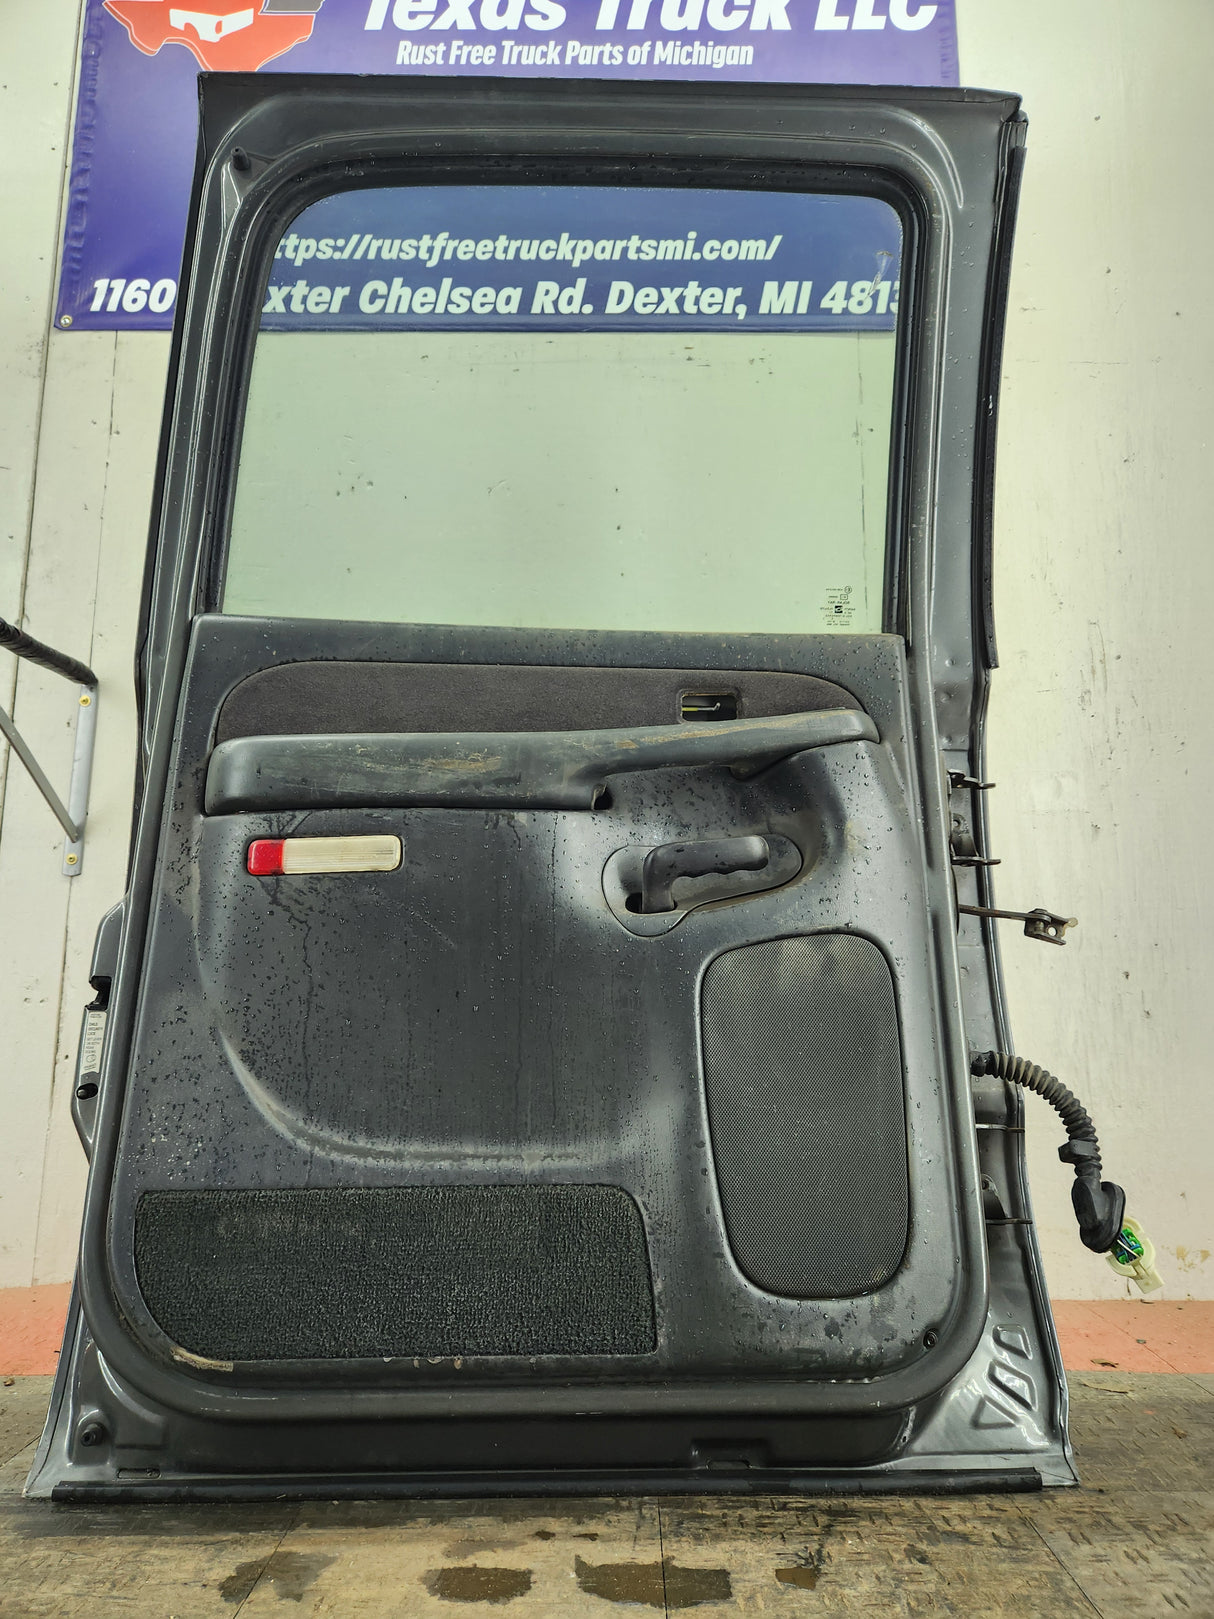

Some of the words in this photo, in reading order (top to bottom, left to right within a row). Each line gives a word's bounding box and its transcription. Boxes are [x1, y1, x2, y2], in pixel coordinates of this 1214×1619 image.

[814, 0, 938, 31] LLC
[396, 40, 445, 65] Rust
[449, 40, 497, 65] Free
[501, 40, 563, 65] Truck
[565, 41, 624, 65] Parts
[627, 41, 652, 65] of
[653, 41, 754, 69] Michigan
[274, 231, 783, 267] tps://rustfreetruckpartsmi.com/
[90, 278, 177, 313] 1160
[262, 280, 351, 314] xter
[359, 277, 523, 314] Chelsea
[530, 278, 594, 315] Rd.
[605, 281, 746, 320] Dexter,
[758, 281, 812, 314] MI
